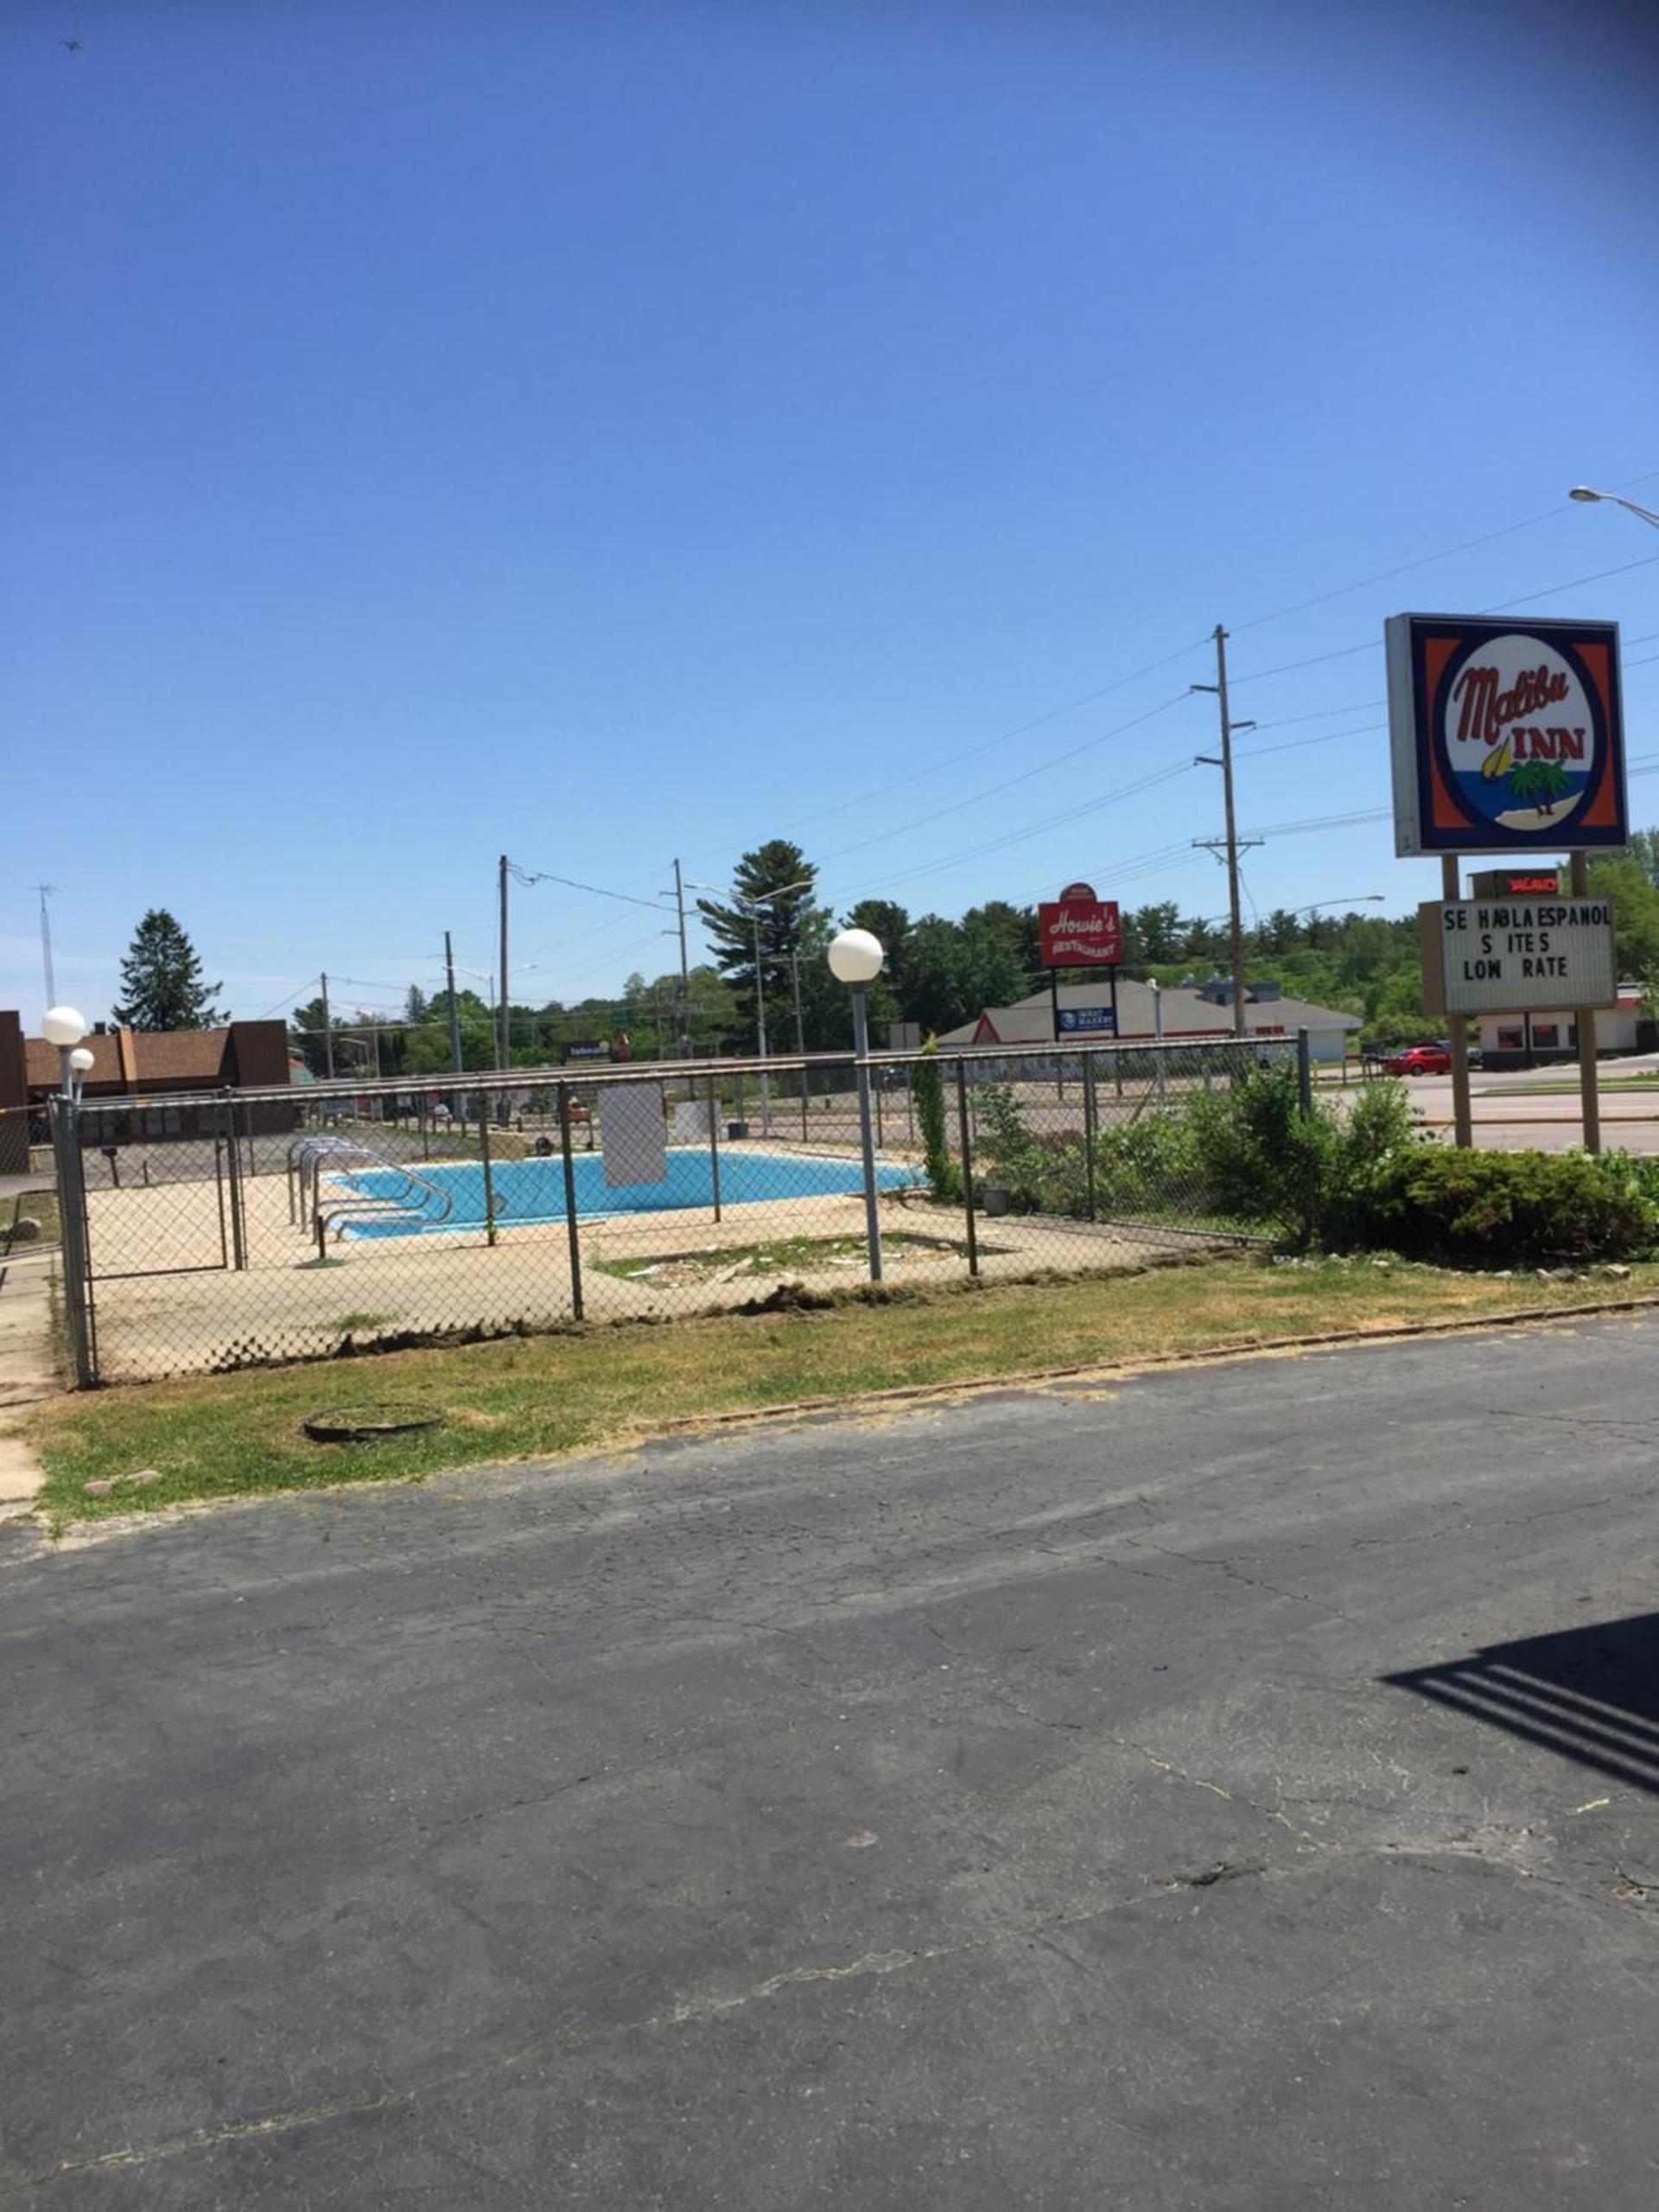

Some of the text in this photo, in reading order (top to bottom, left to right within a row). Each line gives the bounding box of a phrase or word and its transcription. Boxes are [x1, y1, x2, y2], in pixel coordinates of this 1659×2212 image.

[1453, 664, 1569, 746] Malibu
[1511, 728, 1586, 760] INN
[1049, 908, 1116, 934] Howie's
[1444, 910, 1467, 931] SE
[1465, 957, 1567, 981] LOW RATE
